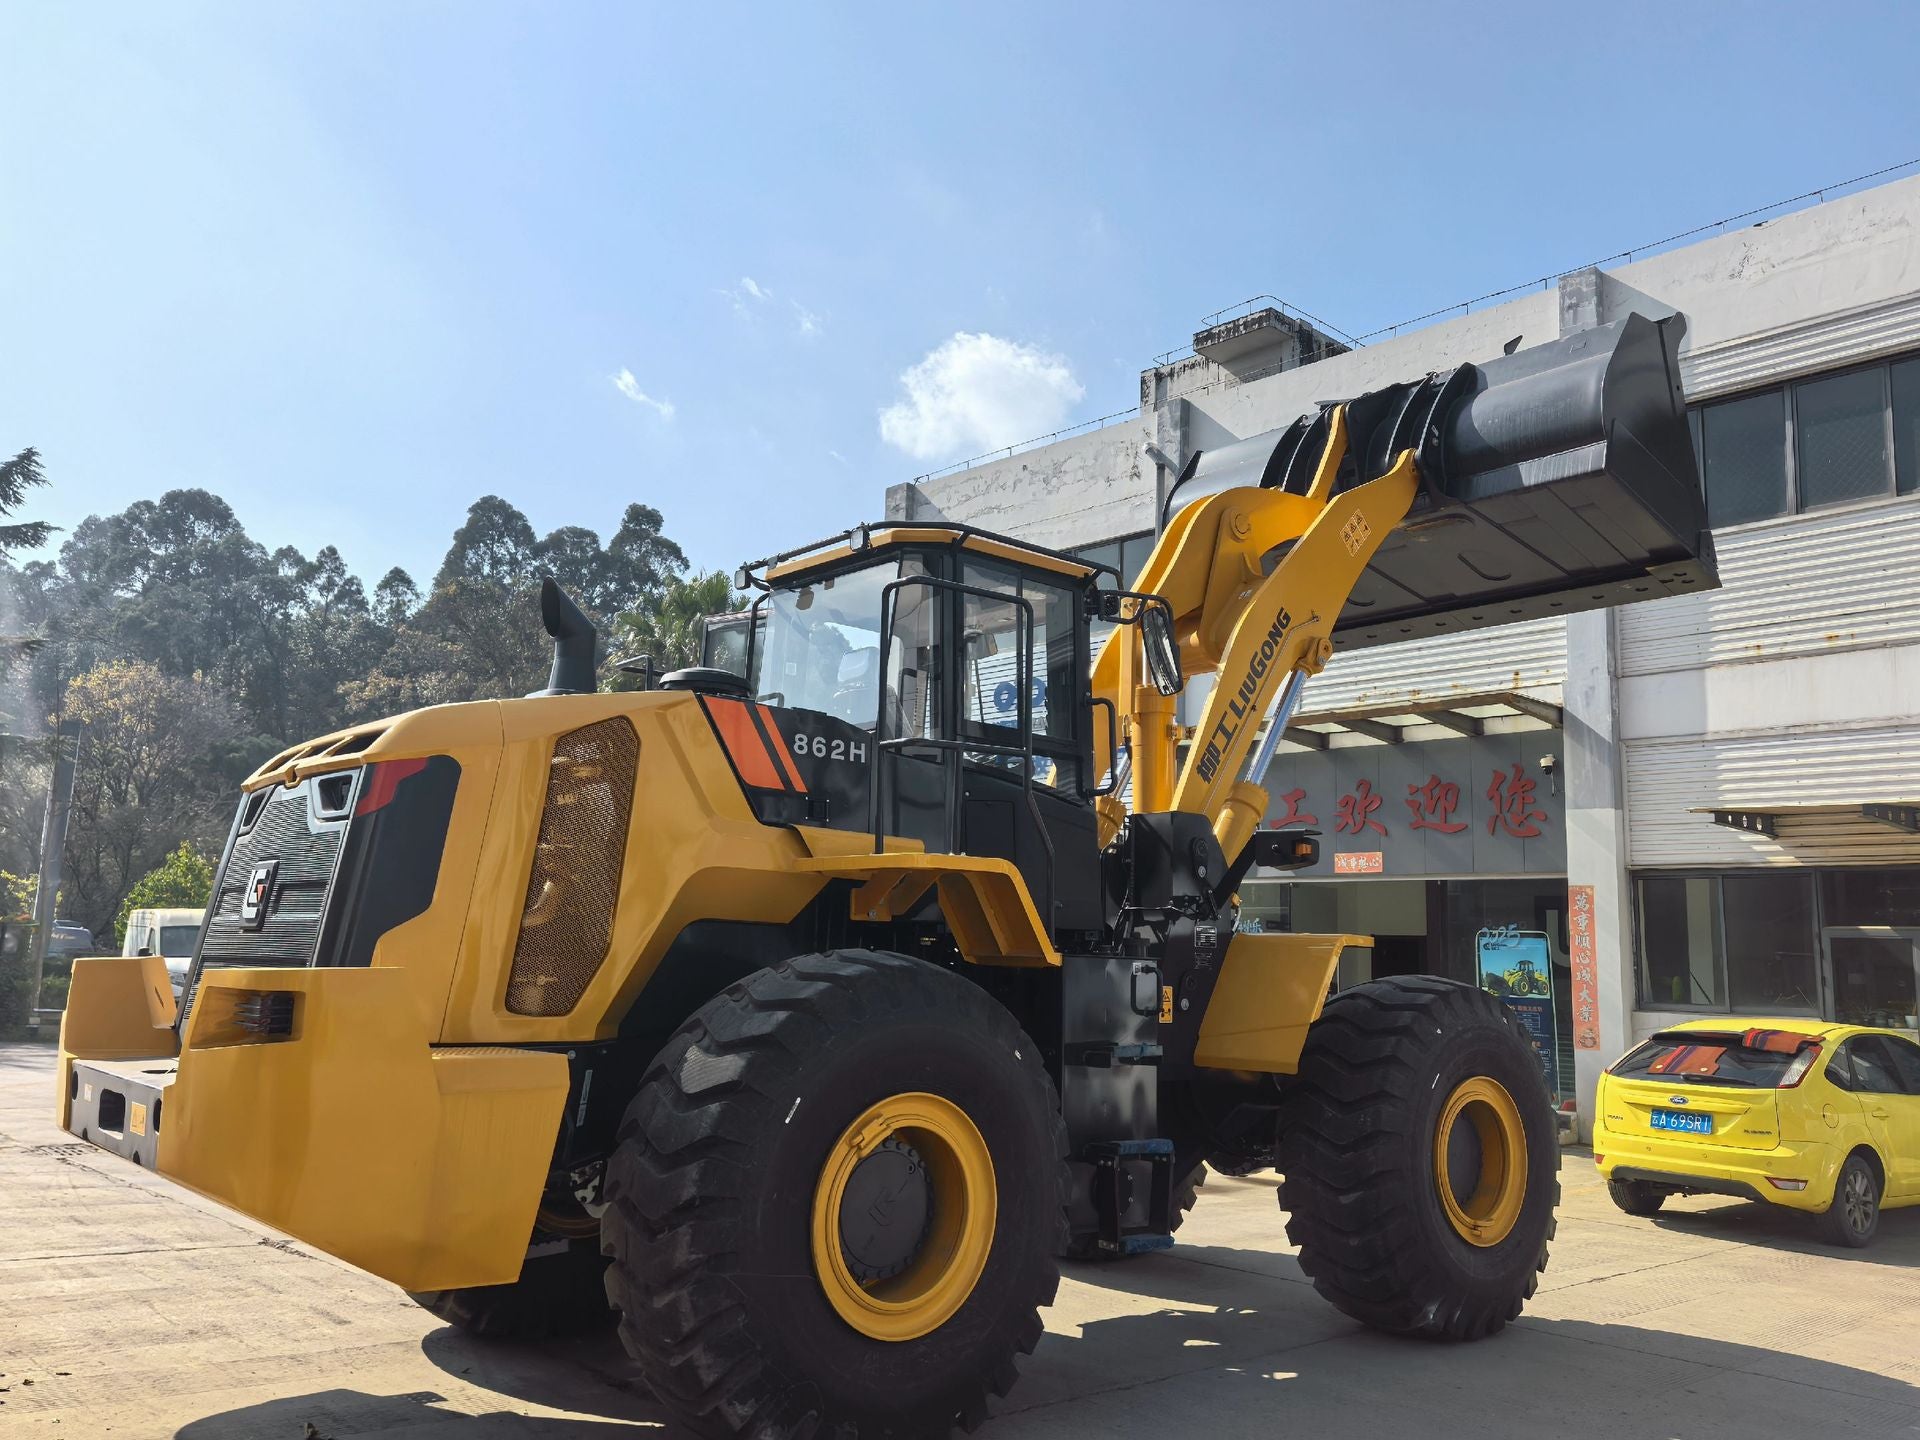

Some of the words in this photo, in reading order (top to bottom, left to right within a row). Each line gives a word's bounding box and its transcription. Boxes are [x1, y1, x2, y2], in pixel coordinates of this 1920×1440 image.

[1196, 711, 1239, 785] 柳工
[1229, 606, 1292, 720] LIUGONG
[793, 733, 866, 764] 862H
[1269, 763, 1548, 838] 工欢迎您
